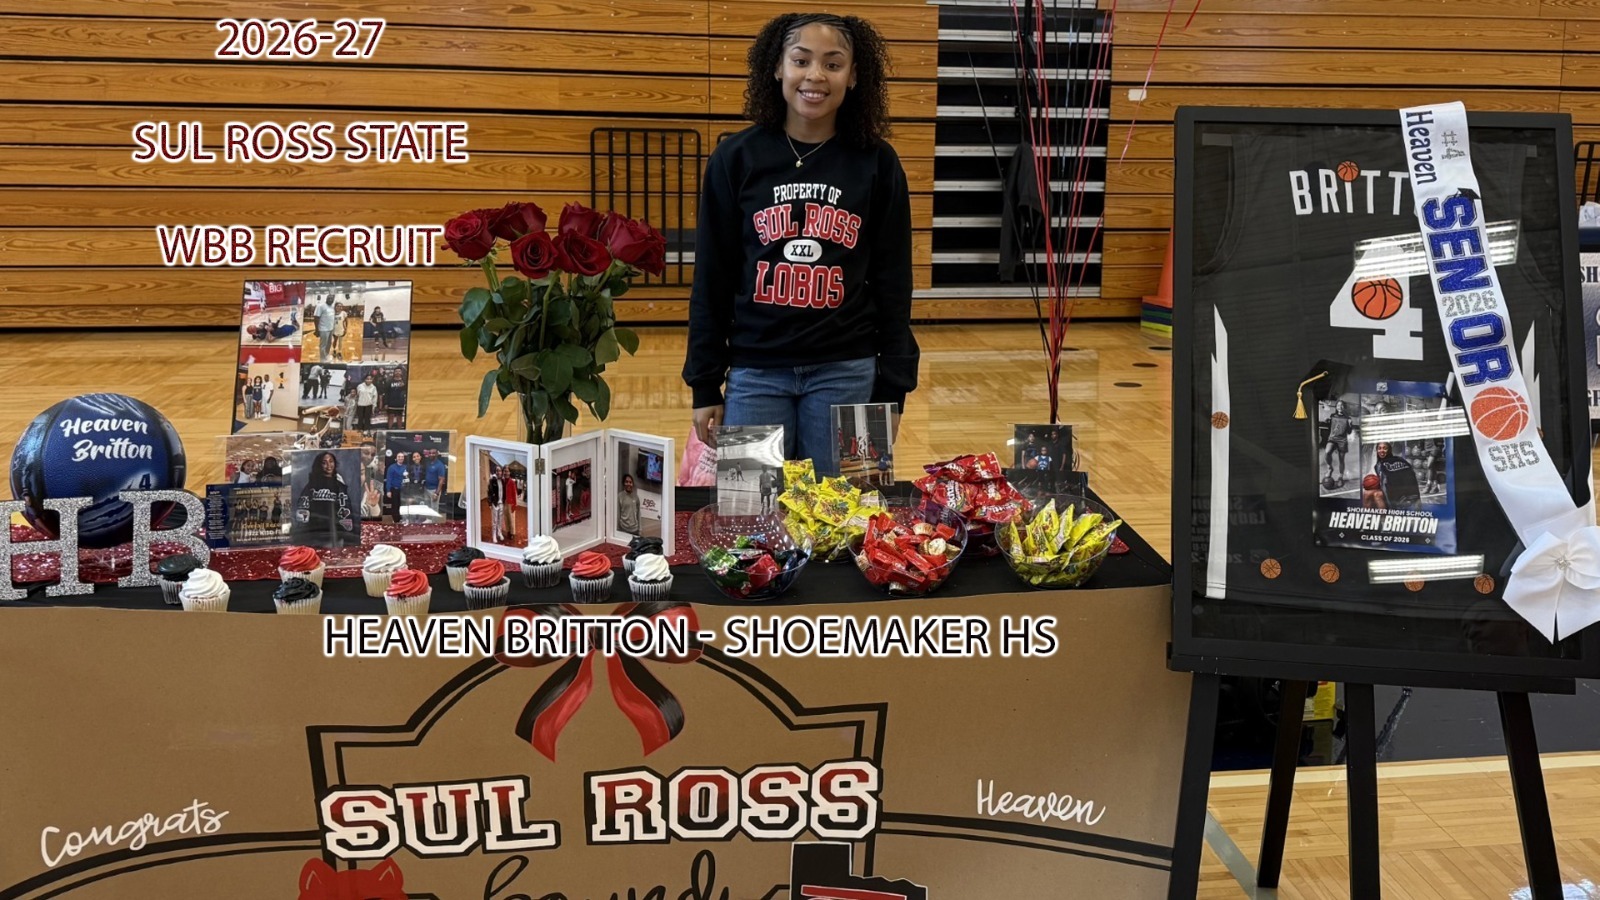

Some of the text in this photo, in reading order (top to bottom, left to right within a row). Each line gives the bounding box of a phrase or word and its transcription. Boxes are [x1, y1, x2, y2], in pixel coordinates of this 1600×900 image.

[1405, 110, 1437, 185] Heaven
[773, 183, 842, 205] PROPERTY OF
[1289, 169, 1416, 216] BRITT
[753, 202, 862, 249] SUL ROSS
[790, 244, 814, 258] XXL
[753, 260, 845, 309] LOBOS
[1330, 247, 1423, 361] 4
[1441, 289, 1498, 318] 2026
[60, 417, 149, 438] Heaven
[71, 437, 153, 462] Britton
[1488, 440, 1540, 473] SHS
[1328, 511, 1438, 535] HEAVEN BRITTON
[1346, 506, 1387, 515] SHOEMAKER
[1406, 510, 1433, 518] SCHOOL
[1361, 534, 1382, 542] CLASS
[322, 758, 882, 859] SUL ROSS
[976, 778, 1108, 827] Heaven
[40, 798, 230, 868] Congrats
